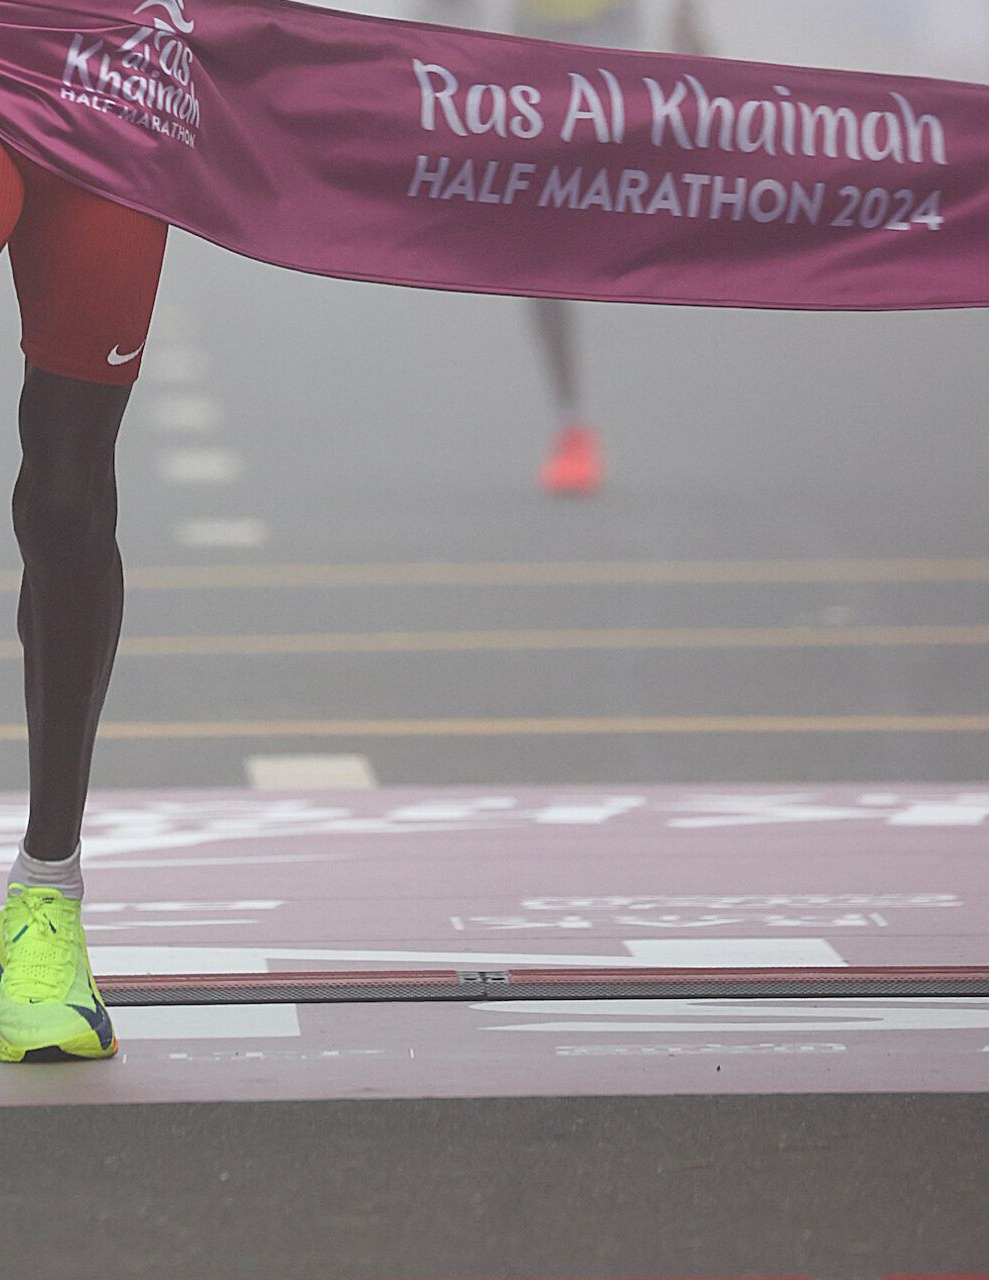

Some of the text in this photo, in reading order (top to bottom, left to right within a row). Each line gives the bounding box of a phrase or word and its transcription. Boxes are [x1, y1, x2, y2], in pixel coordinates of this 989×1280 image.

[60, 87, 197, 149] HALF MARATHON
[62, 32, 201, 128] Khaimah
[412, 57, 949, 166] Ras Al Khaimah
[407, 154, 946, 232] HALF MARATHON 2024
